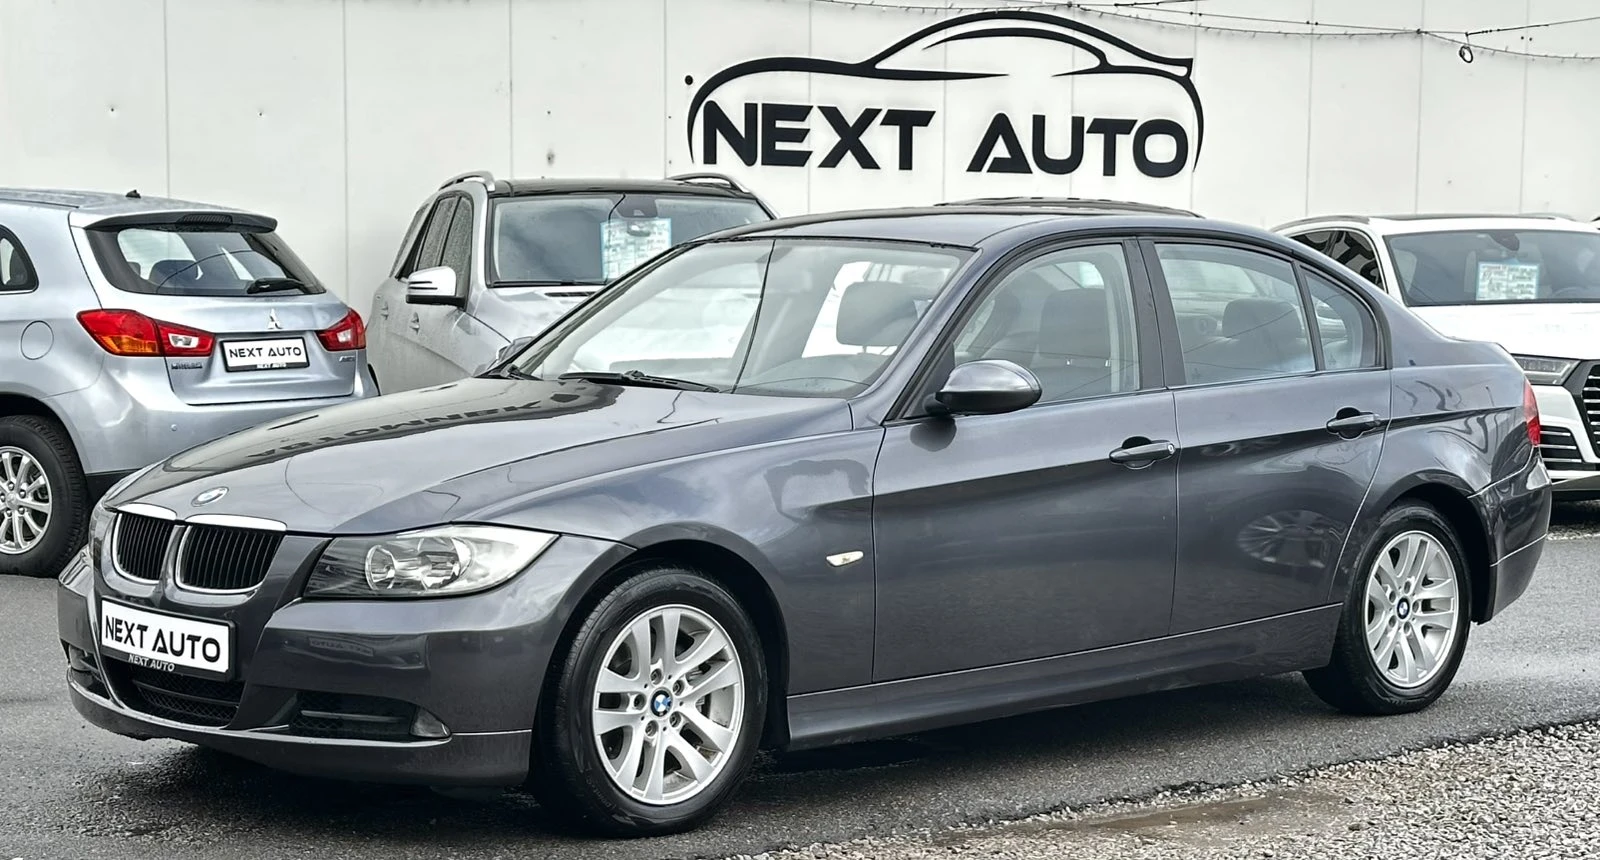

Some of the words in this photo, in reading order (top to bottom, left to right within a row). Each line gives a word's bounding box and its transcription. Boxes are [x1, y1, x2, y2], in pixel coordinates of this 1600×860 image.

[703, 100, 936, 171] NEXT
[966, 112, 1189, 178] AUTO
[229, 347, 263, 358] NEXT
[268, 346, 302, 357] AUTO
[105, 615, 149, 649] NEXT
[152, 628, 221, 663] AUTO
[128, 653, 149, 667] NEXT
[150, 659, 175, 672] AUTO
